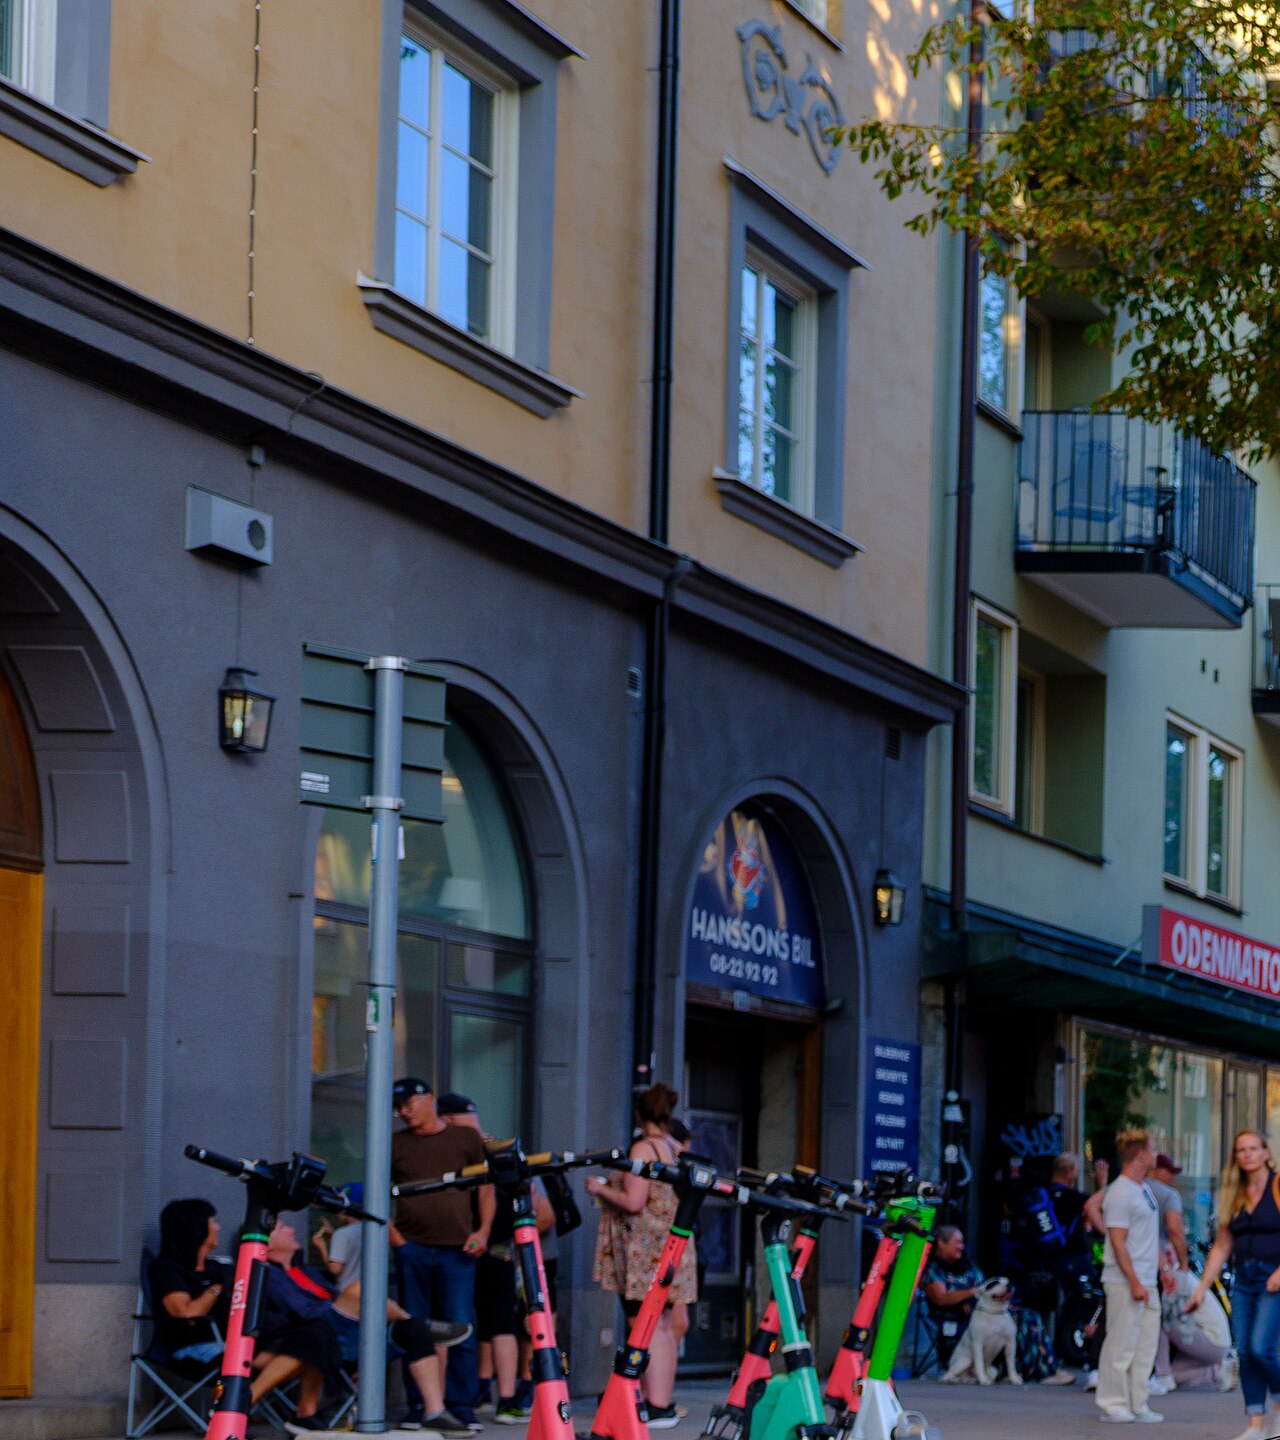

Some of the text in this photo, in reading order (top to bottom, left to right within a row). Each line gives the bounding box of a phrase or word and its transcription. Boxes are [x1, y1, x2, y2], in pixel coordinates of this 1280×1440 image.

[692, 906, 816, 968] HANSSONS BIL
[709, 952, 778, 986] 08-22 92 92
